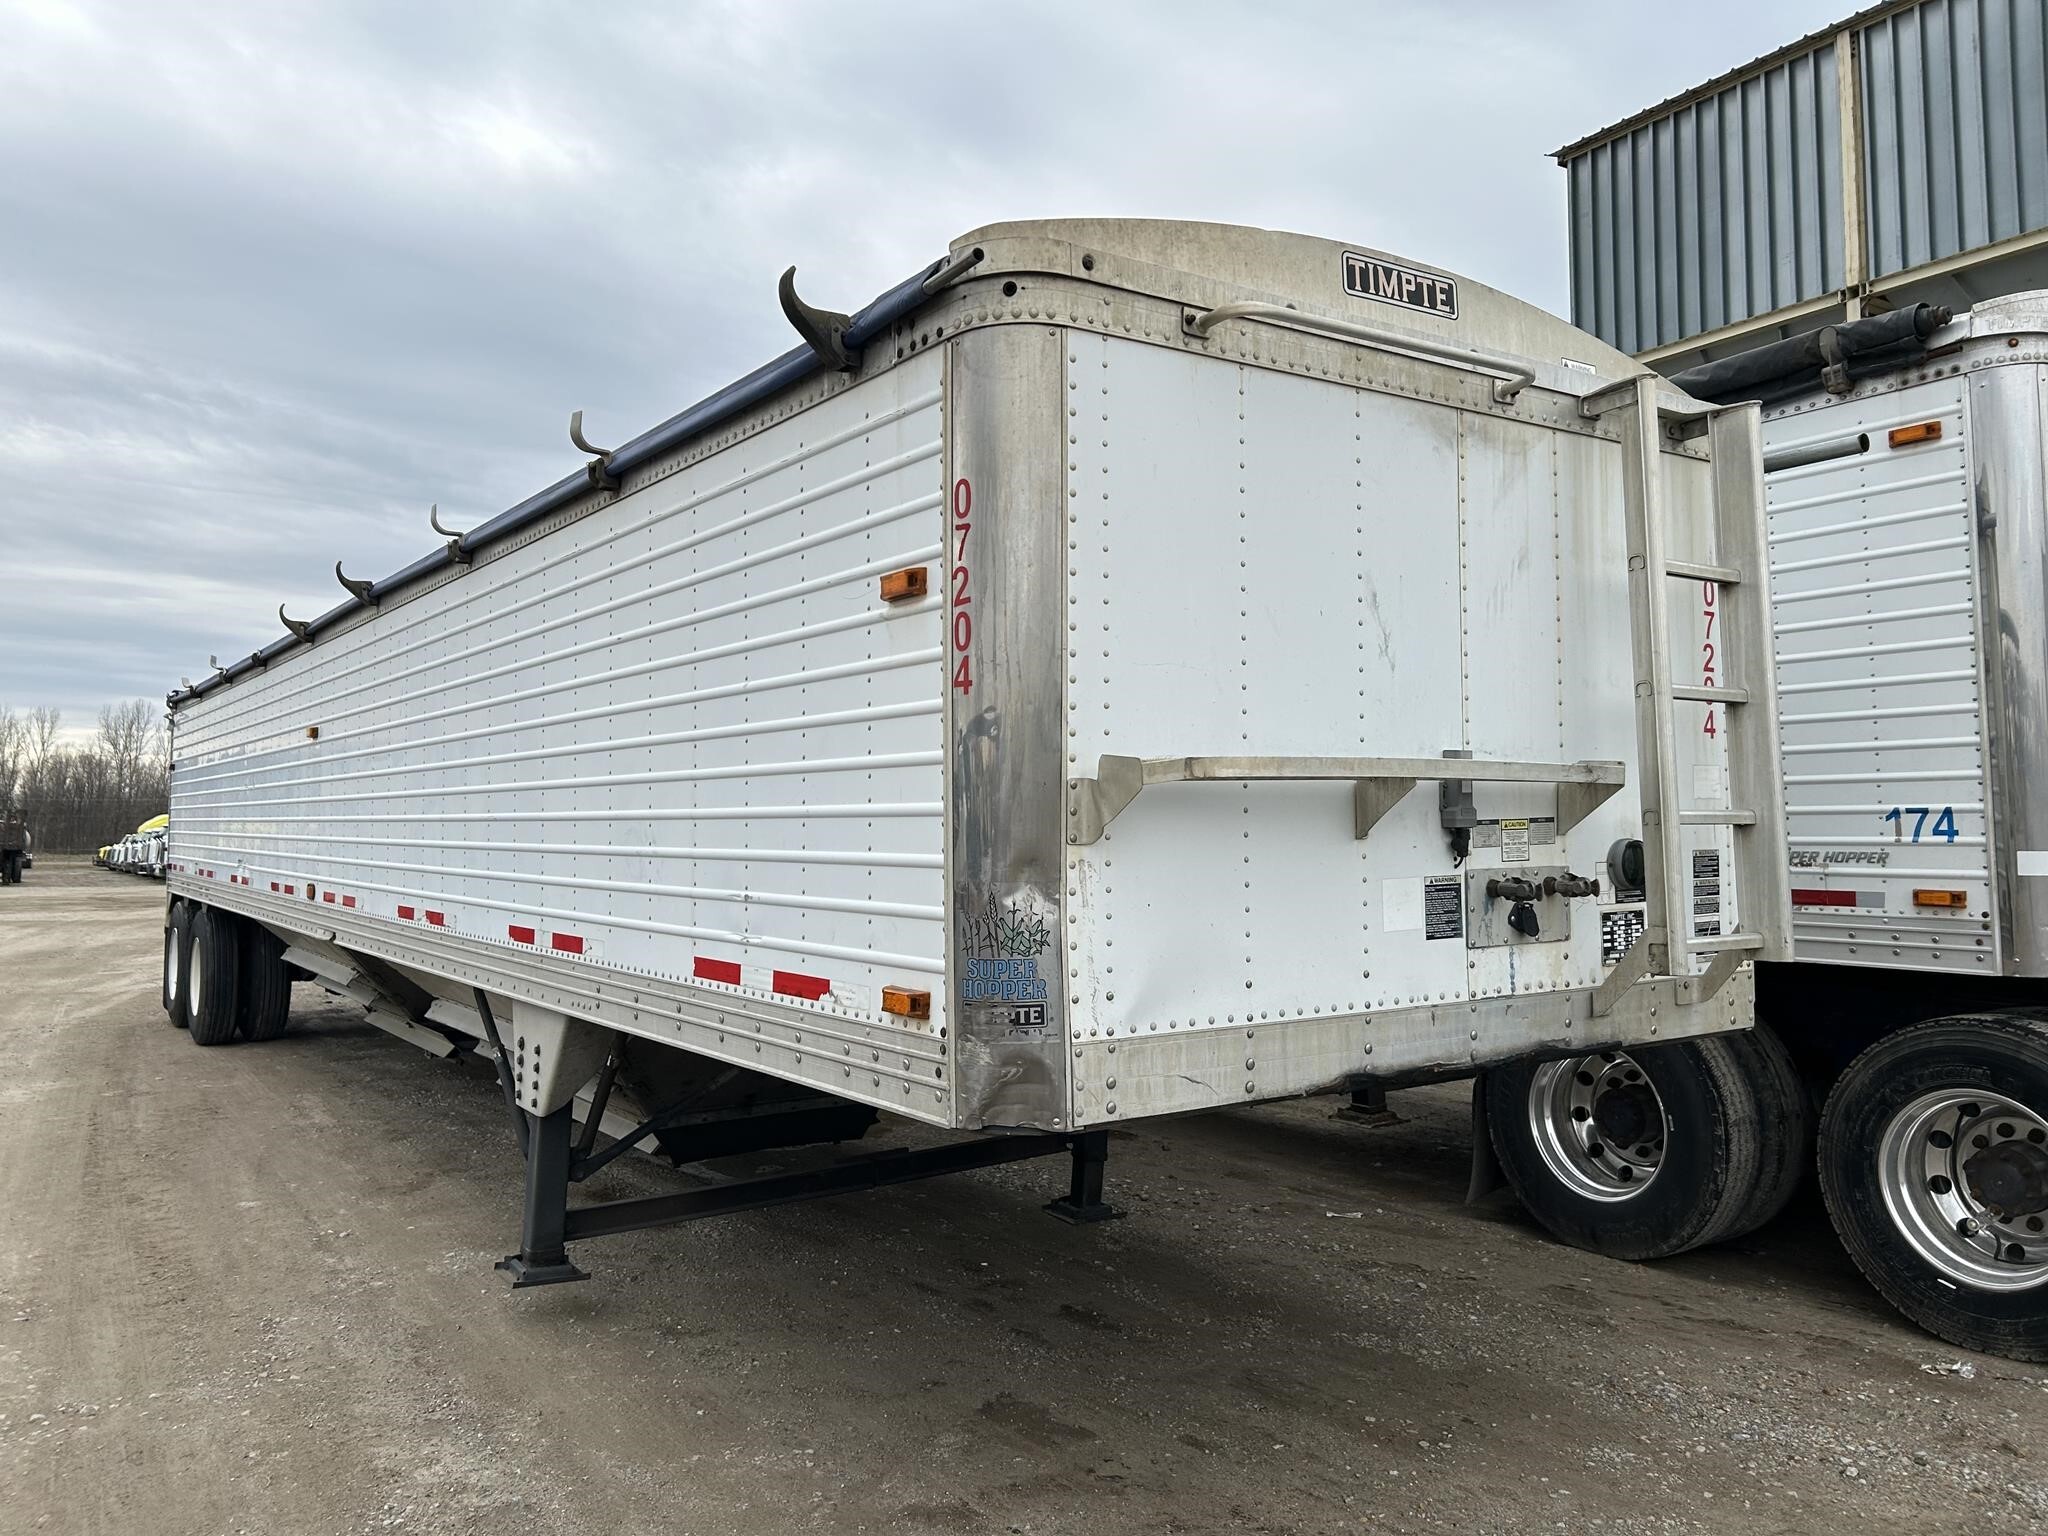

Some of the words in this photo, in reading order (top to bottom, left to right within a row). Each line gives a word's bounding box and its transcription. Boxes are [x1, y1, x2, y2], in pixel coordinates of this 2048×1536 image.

[1348, 260, 1451, 313] TIMPTE
[952, 478, 973, 696] 07204
[1885, 807, 1959, 843] 174
[1789, 850, 1820, 865] PER
[1823, 851, 1890, 864] HOPPER
[1434, 876, 1457, 884] WARNING
[967, 958, 1038, 980] SUPER
[962, 979, 1048, 1001] HOPPER
